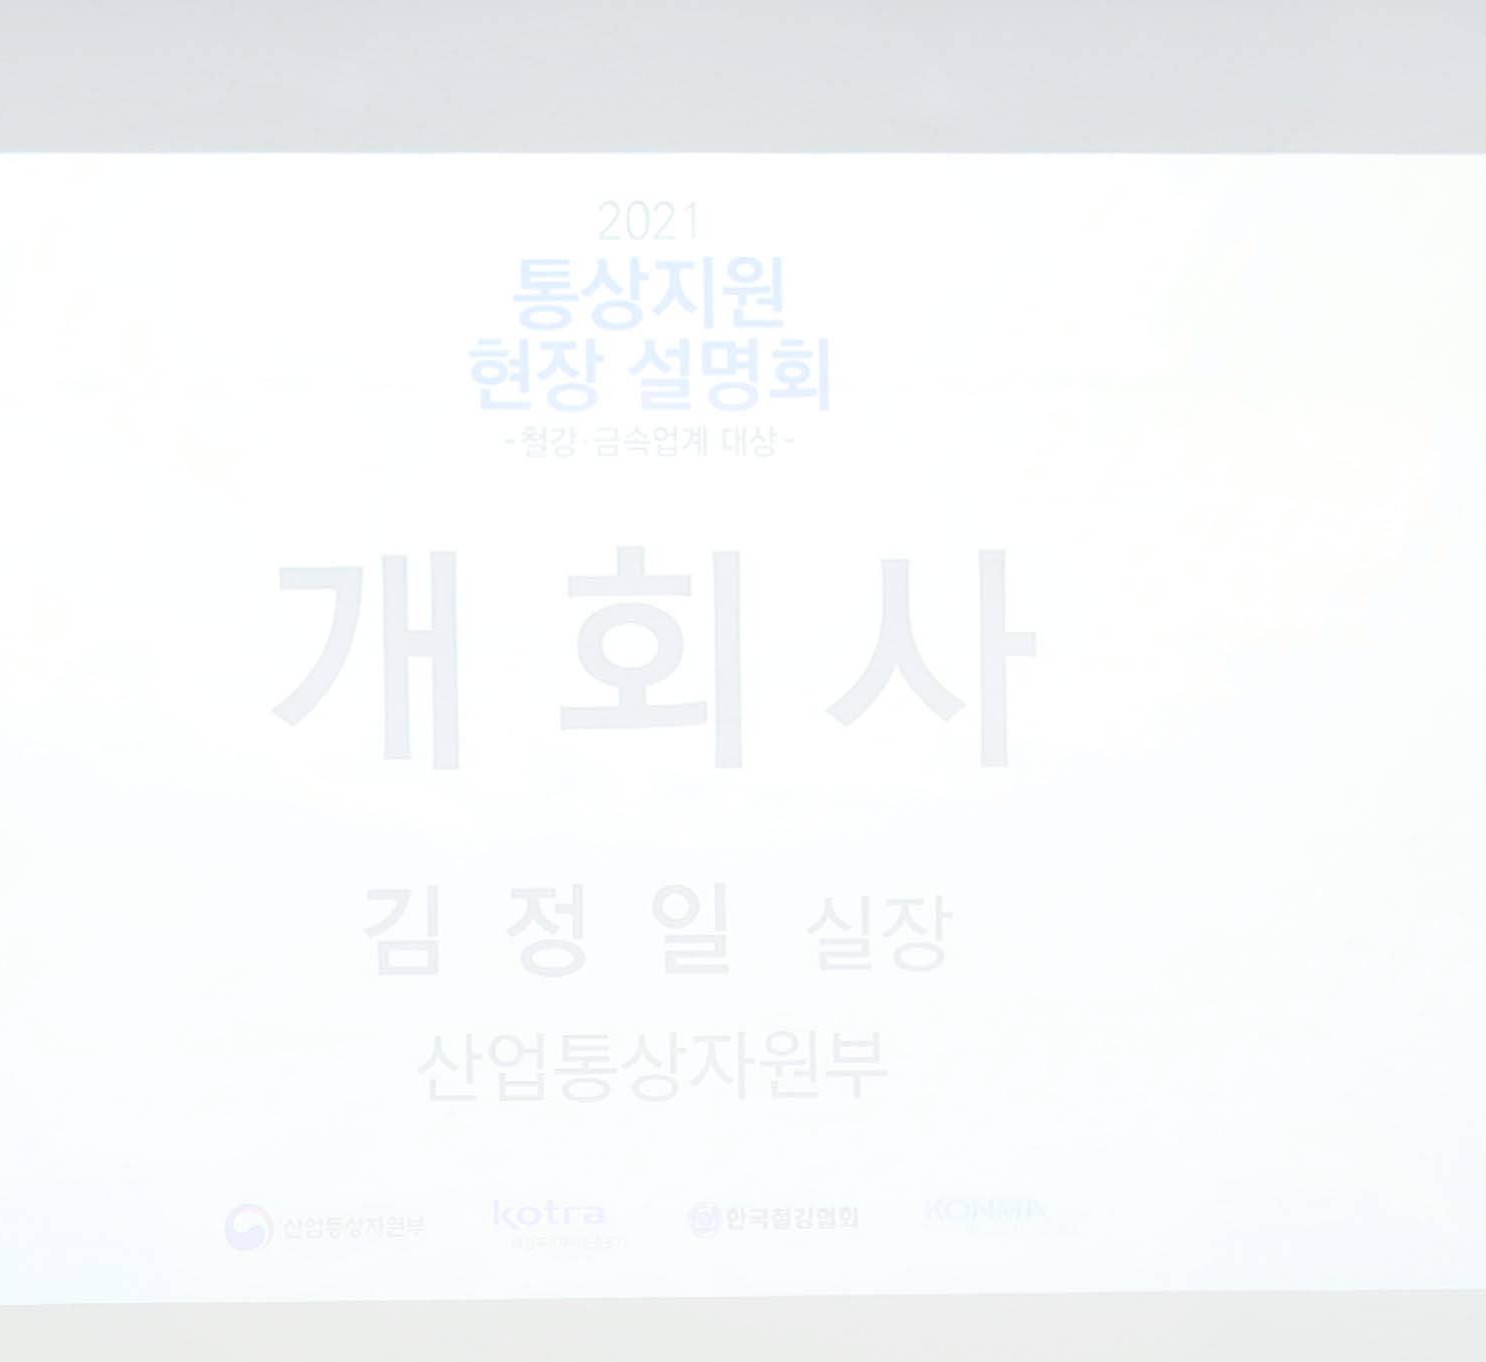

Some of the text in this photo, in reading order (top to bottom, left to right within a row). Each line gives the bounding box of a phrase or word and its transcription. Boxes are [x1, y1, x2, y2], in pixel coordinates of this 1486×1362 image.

[598, 199, 696, 241] 2021
[512, 255, 785, 332] 통상지원
[467, 336, 830, 413] 현장 설명회
[270, 544, 1037, 771] 개 회 사
[805, 893, 954, 973] 실장
[417, 1024, 890, 1104] 산업통상자원부
[491, 1198, 608, 1230] kotra
